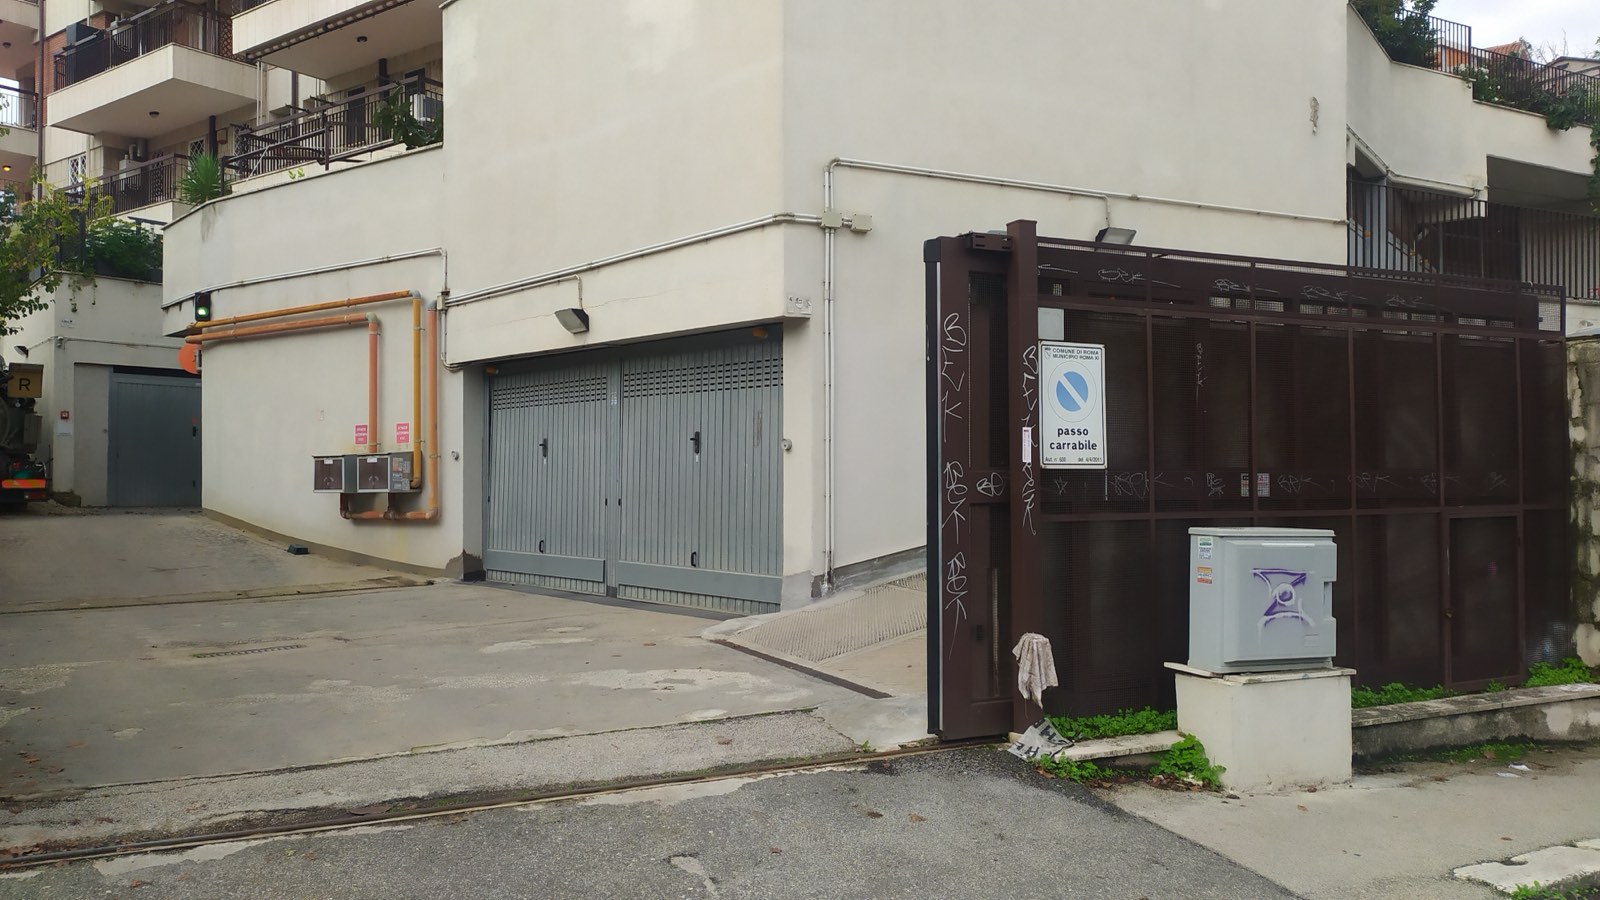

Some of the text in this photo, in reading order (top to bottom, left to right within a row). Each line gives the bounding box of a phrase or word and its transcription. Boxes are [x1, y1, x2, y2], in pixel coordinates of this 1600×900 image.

[18, 377, 31, 391] R
[1057, 427, 1089, 437] passo
[1049, 439, 1098, 450] carrabile
